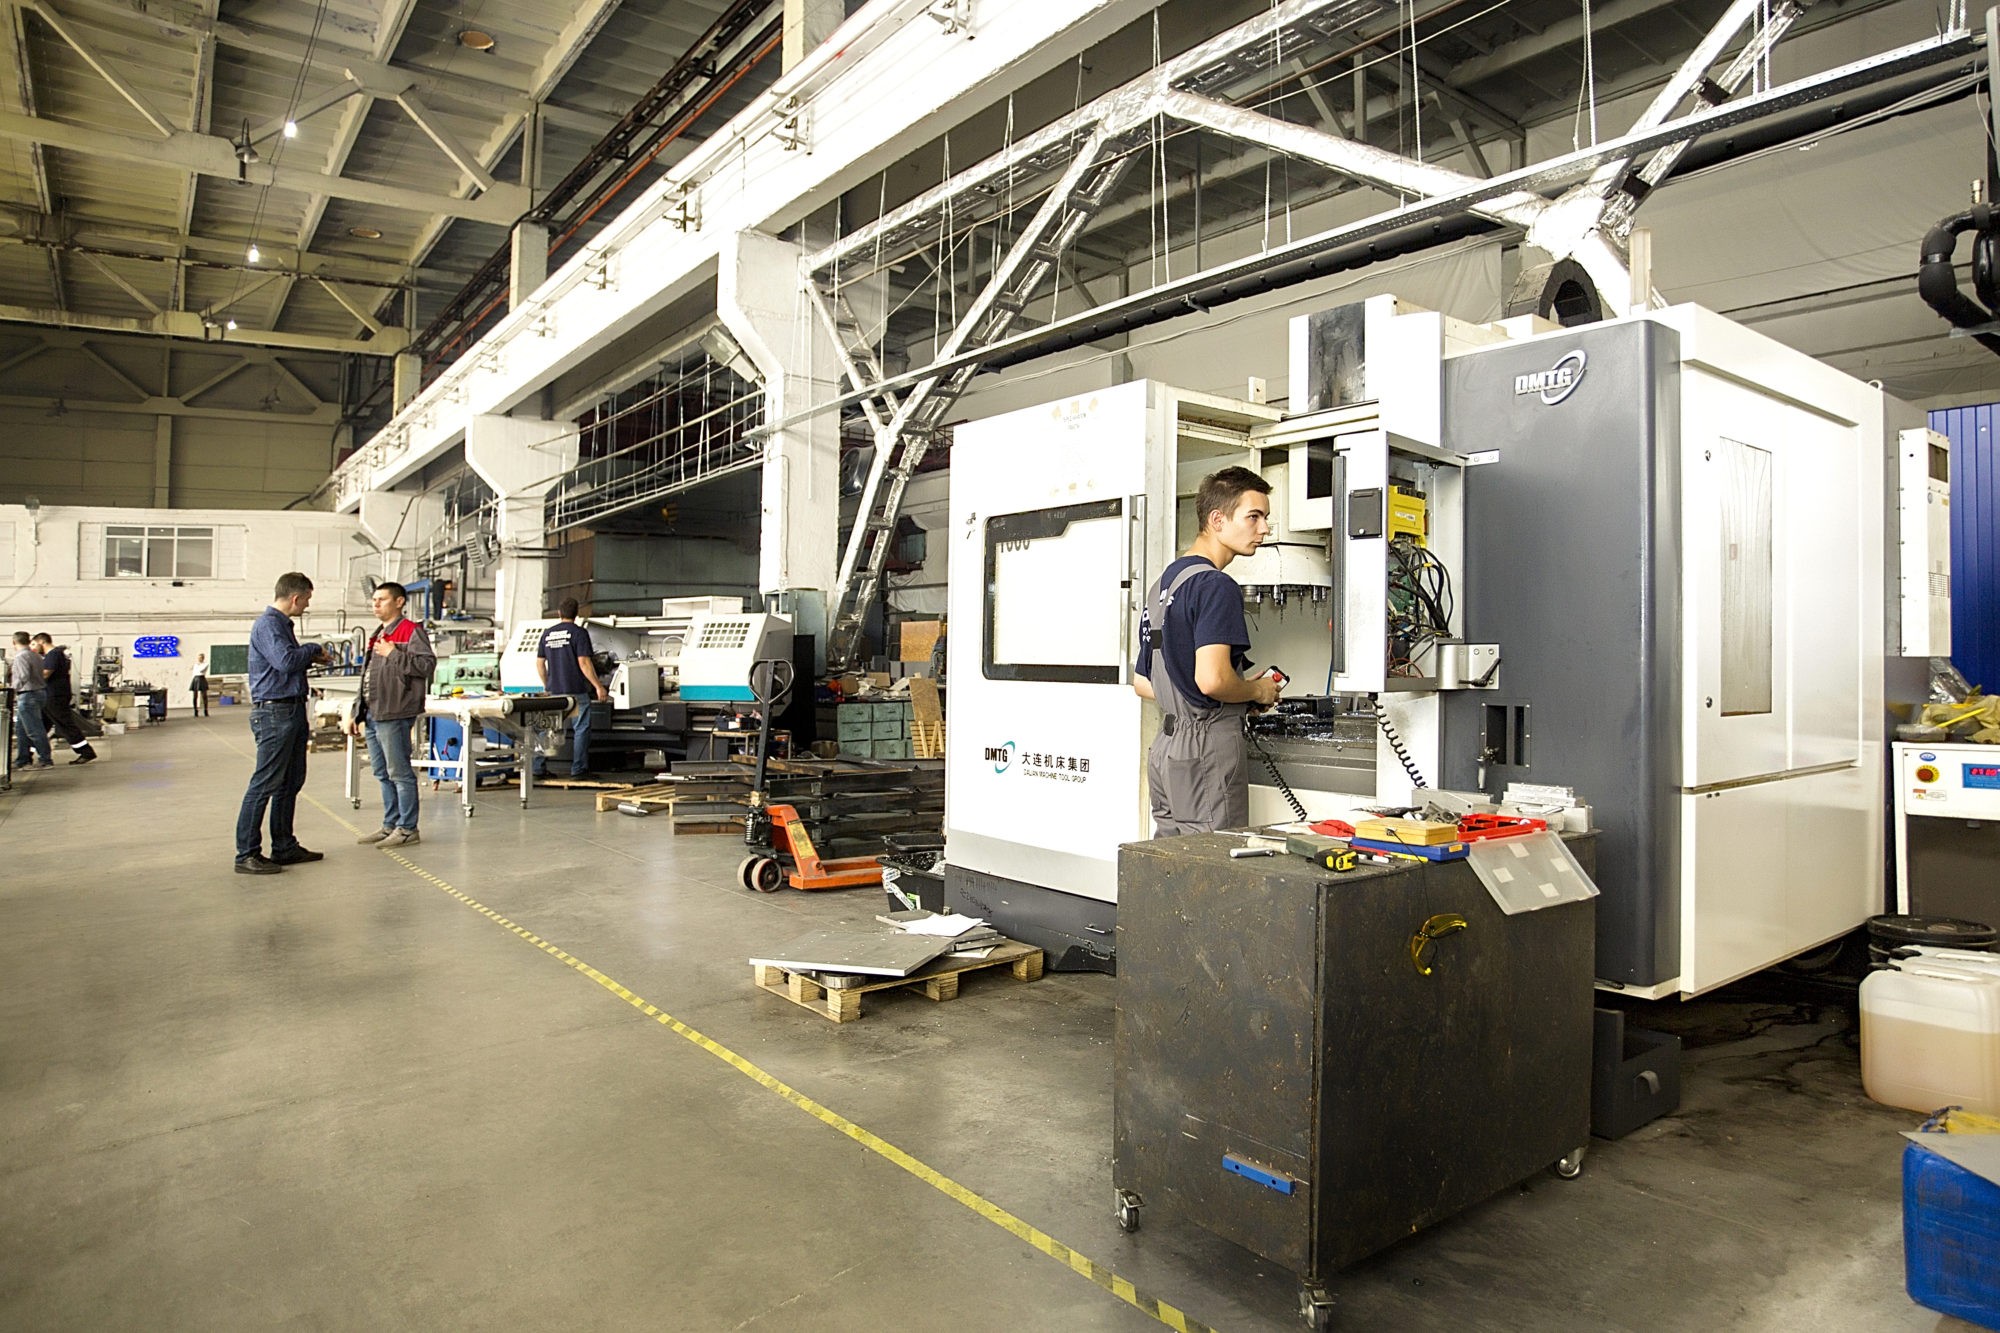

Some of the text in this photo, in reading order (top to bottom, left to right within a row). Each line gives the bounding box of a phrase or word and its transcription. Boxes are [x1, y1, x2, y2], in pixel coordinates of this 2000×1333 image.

[1515, 367, 1573, 395] DMTG
[984, 747, 1008, 763] DMTG
[1021, 751, 1090, 773] 大连机床集团
[1039, 770, 1057, 780] MACHINE
[1058, 772, 1071, 782] TOOL
[1071, 774, 1087, 784] GROUP
